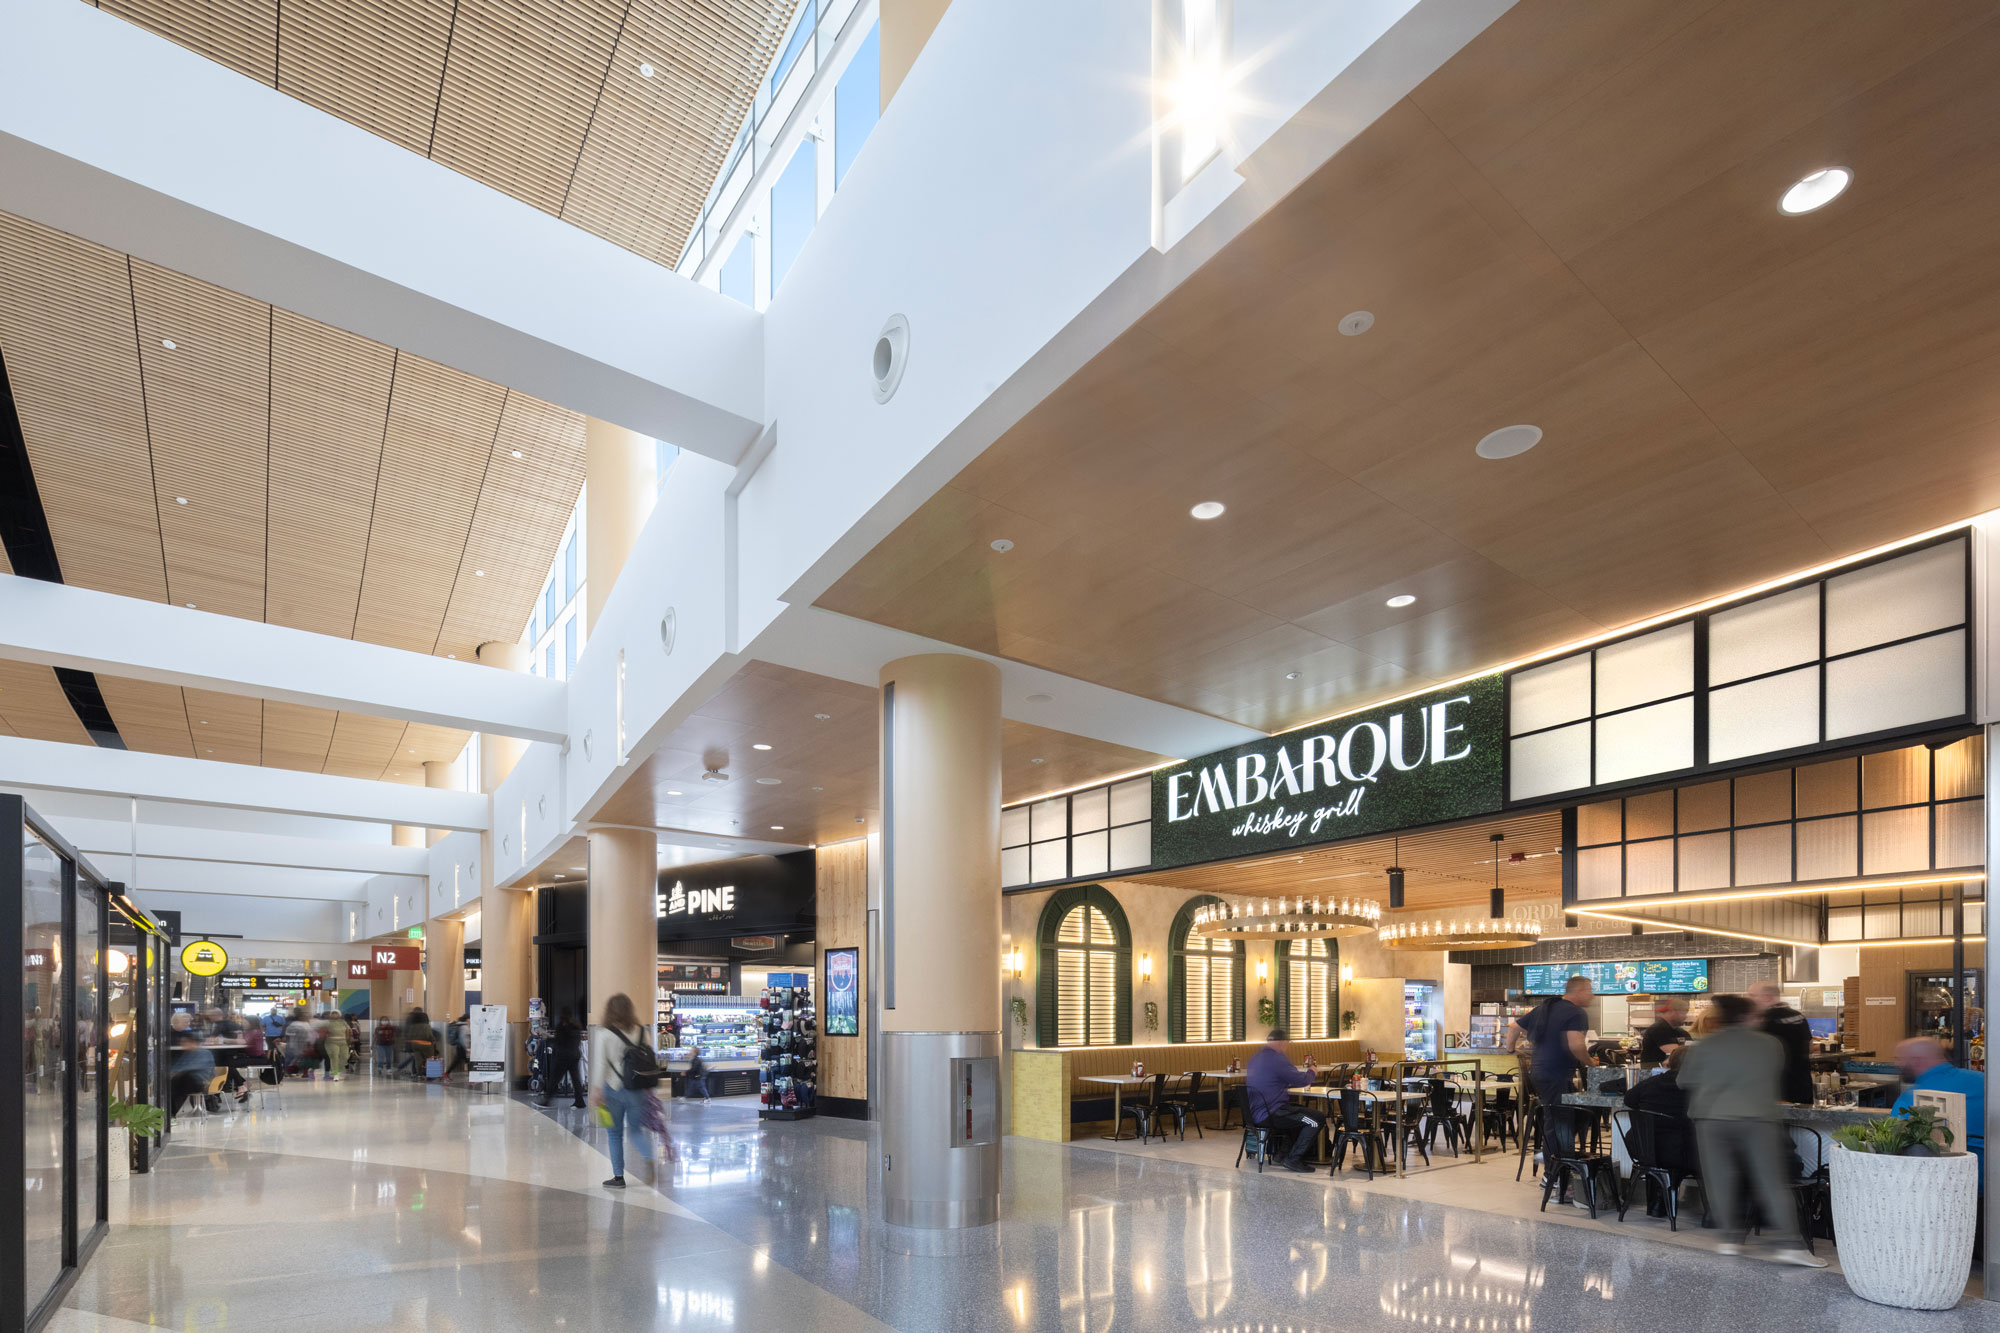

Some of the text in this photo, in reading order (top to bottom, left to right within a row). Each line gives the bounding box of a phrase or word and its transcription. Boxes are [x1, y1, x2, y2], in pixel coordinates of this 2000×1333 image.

[1168, 695, 1471, 823] EMBARQUE
[1232, 786, 1366, 838] whiskey grill
[669, 898, 686, 911] AND
[687, 886, 735, 915] PINE
[351, 964, 367, 976] N1
[376, 951, 396, 964] N2
